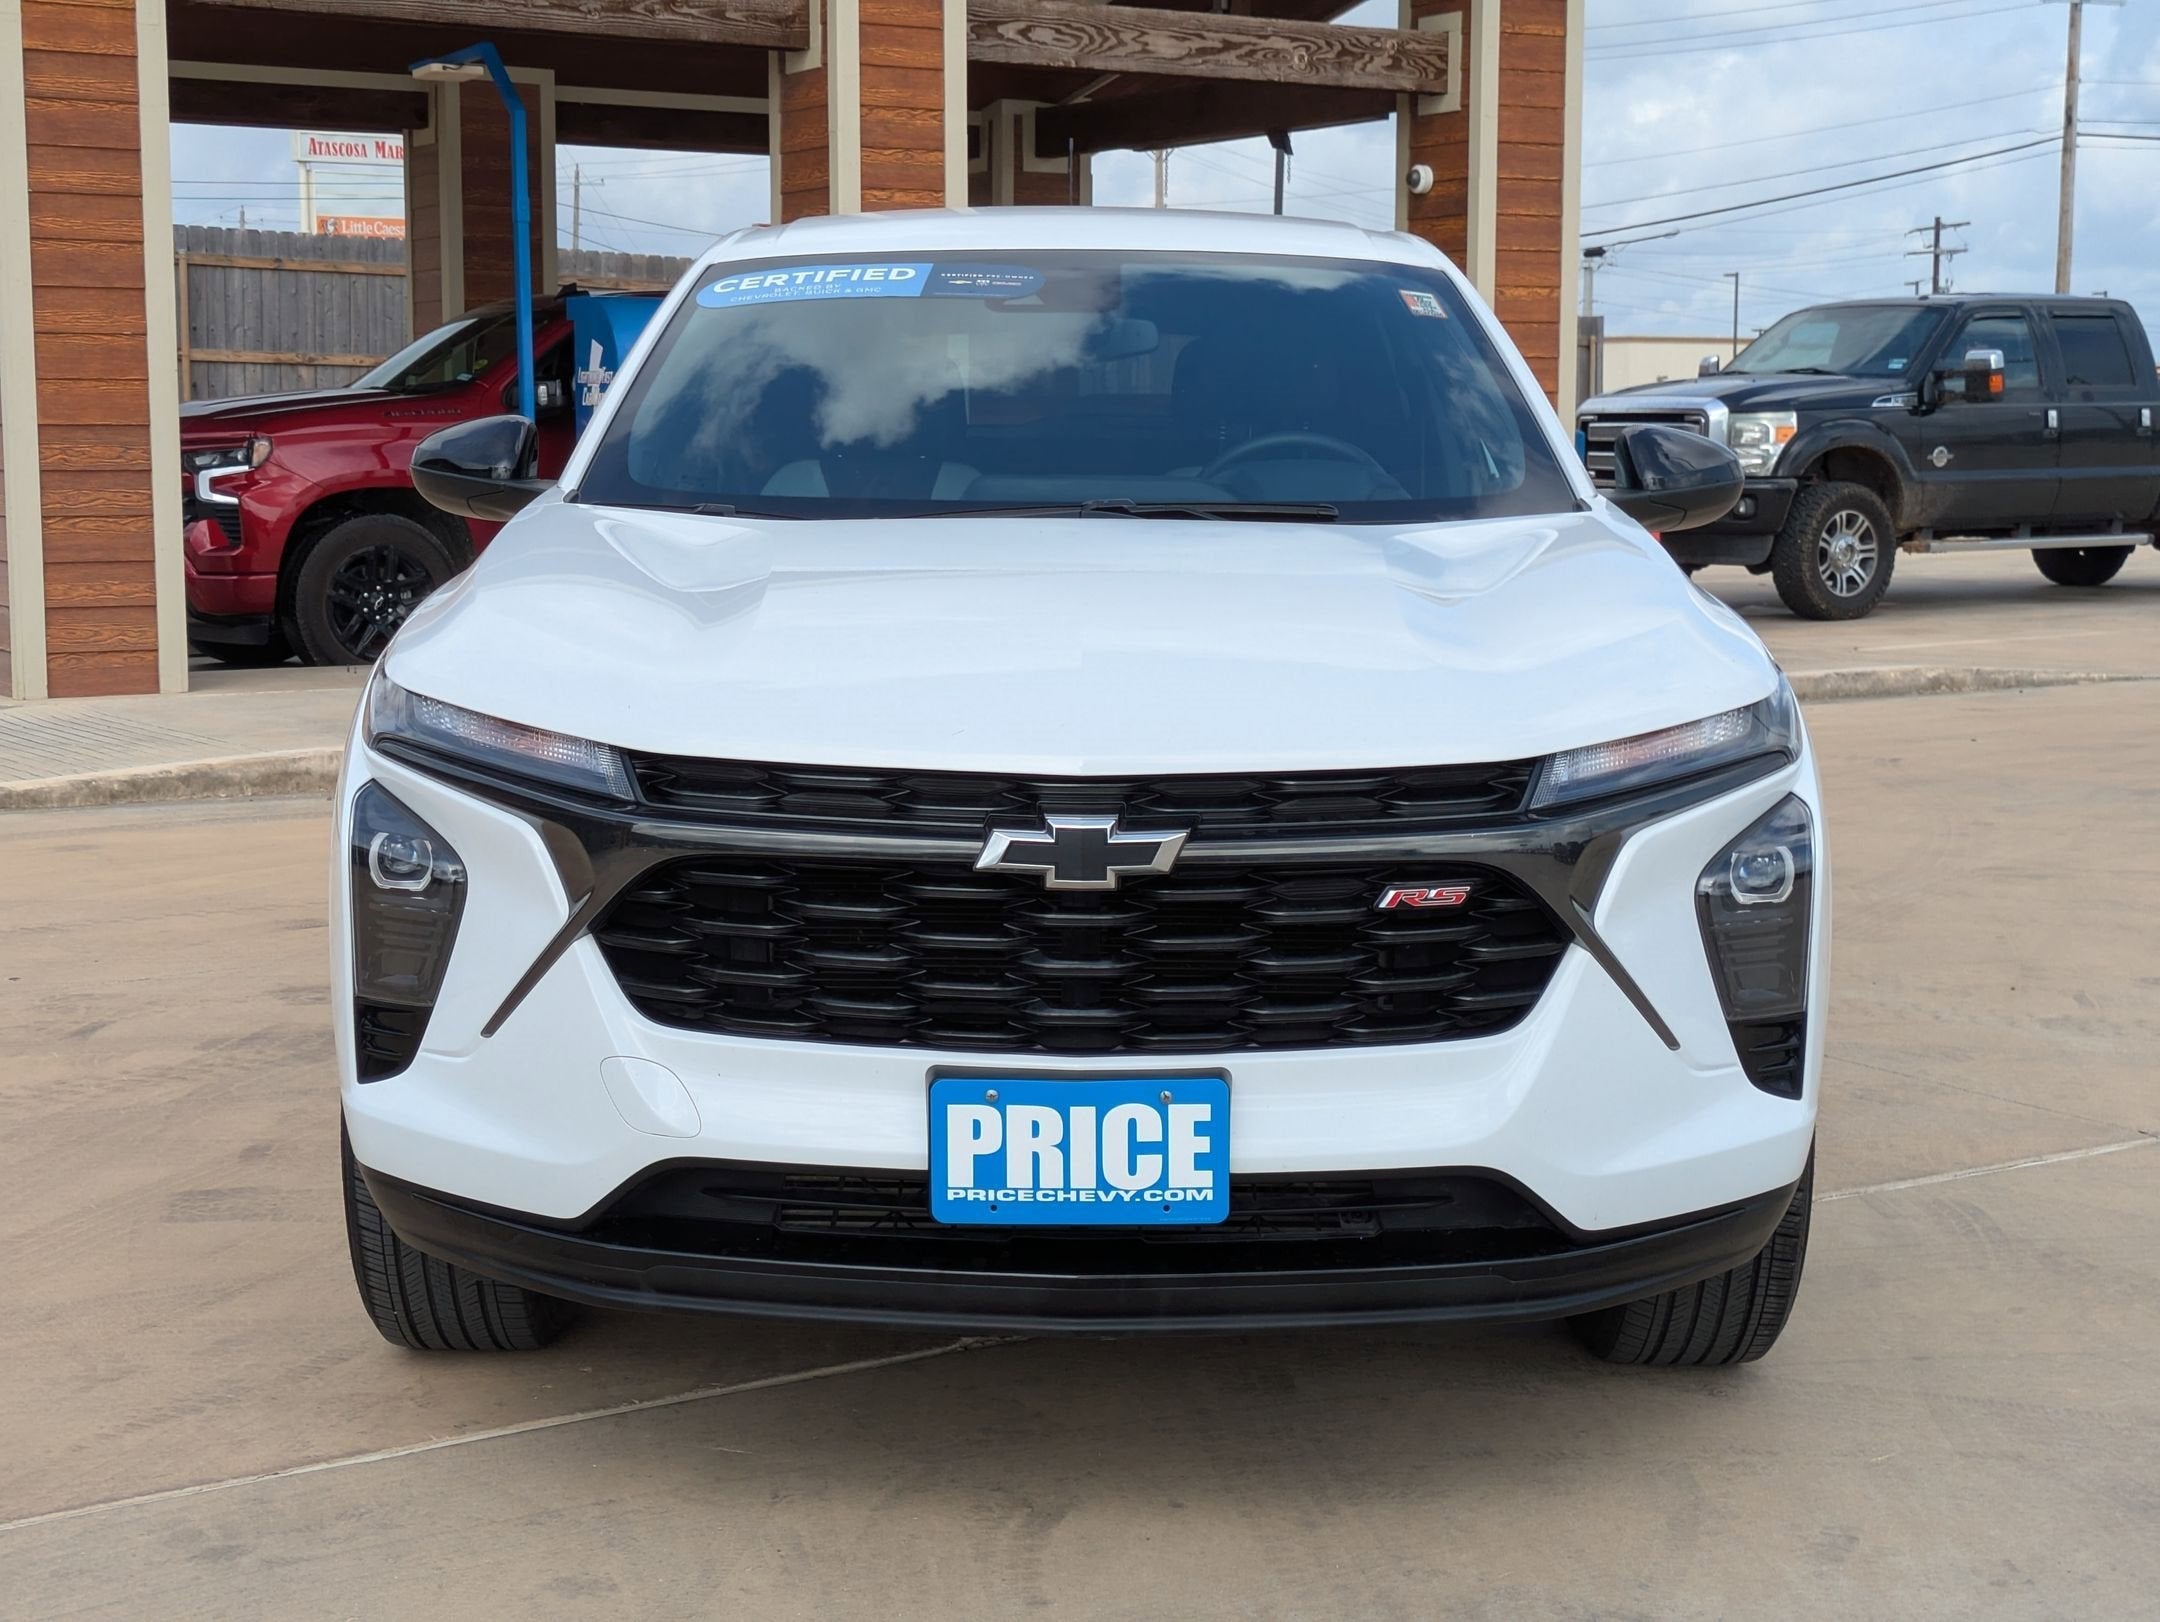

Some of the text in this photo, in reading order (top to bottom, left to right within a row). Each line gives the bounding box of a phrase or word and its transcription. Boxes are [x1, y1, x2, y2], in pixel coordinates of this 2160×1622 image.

[308, 137, 368, 158] ATASCOSA
[342, 220, 372, 235] Little
[713, 267, 917, 293] CERTIFIED
[774, 284, 822, 293] BACKED
[804, 287, 840, 297] BUICK
[1378, 886, 1471, 908] RS
[946, 1103, 1213, 1190] PRICE
[946, 1189, 1213, 1202] PRICECHEVY.COM
